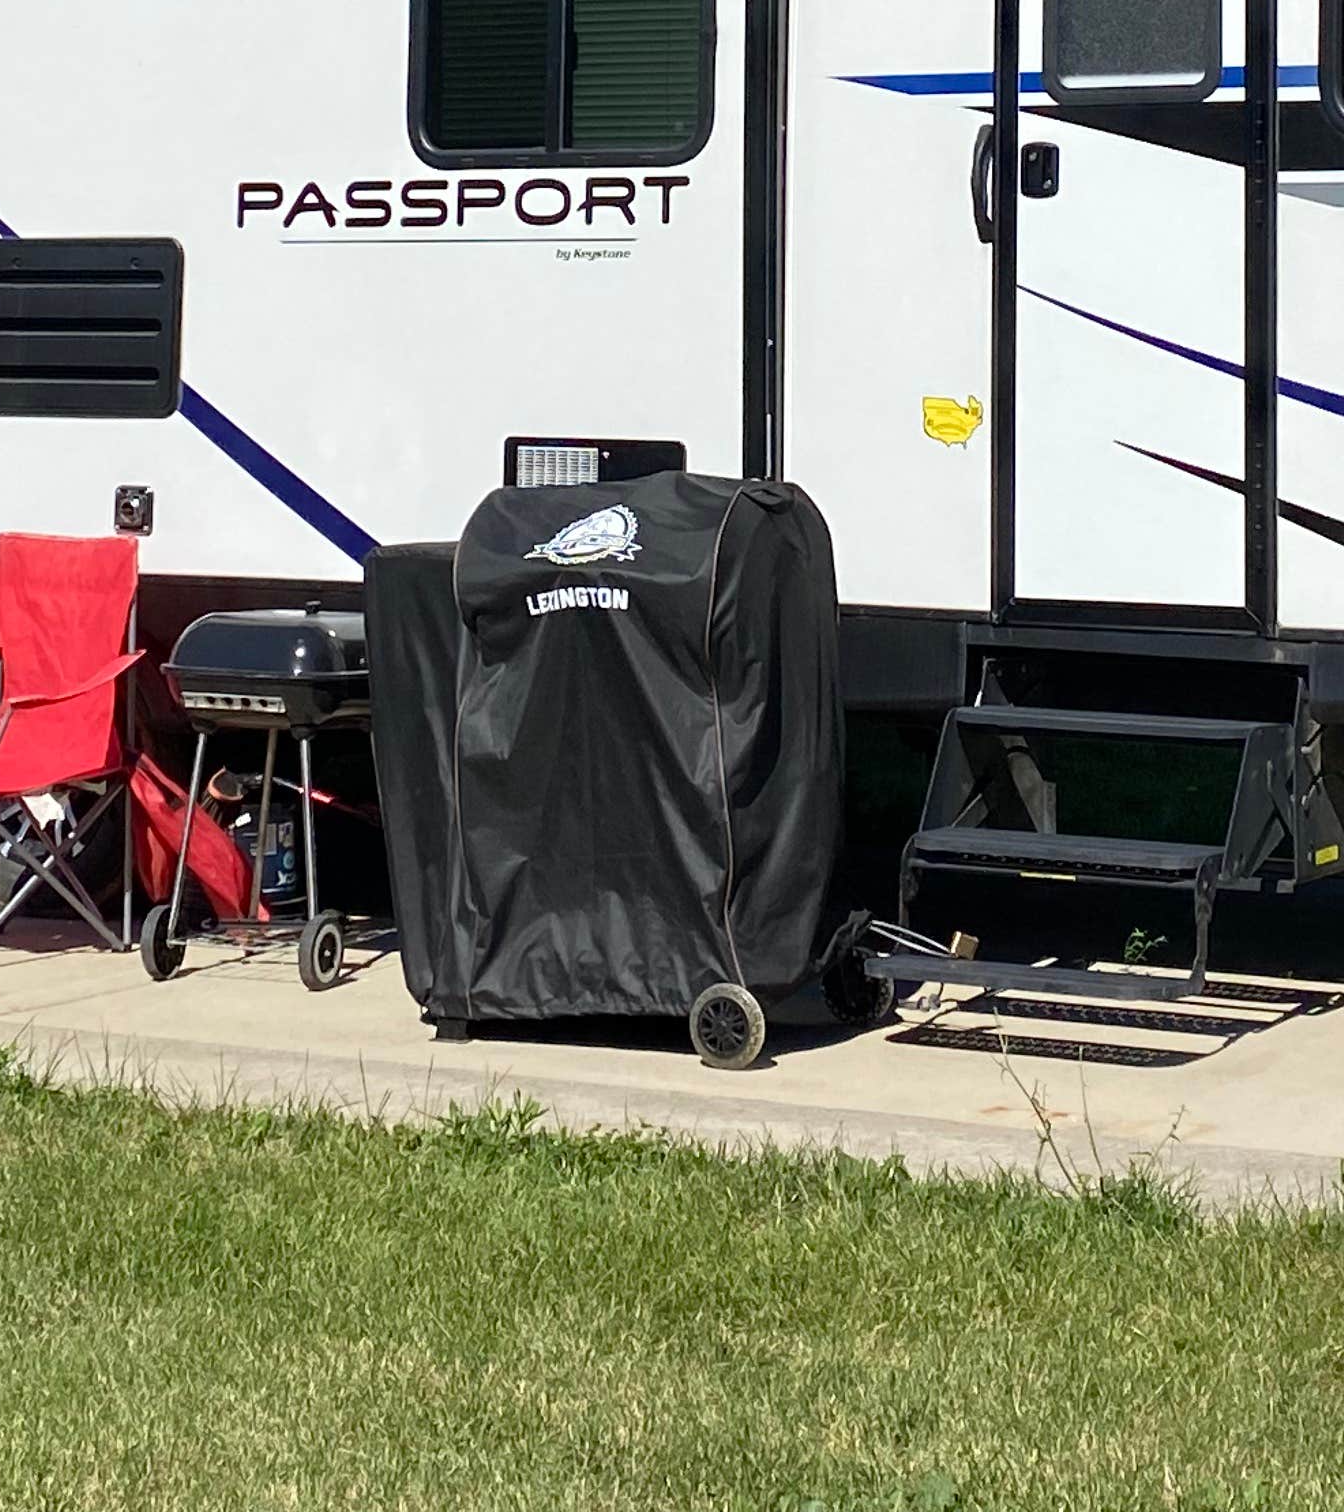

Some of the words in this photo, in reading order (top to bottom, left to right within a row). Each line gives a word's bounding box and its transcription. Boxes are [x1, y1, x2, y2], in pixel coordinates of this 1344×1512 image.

[236, 175, 691, 229] PASSPORT
[555, 248, 571, 261] by
[573, 248, 632, 261] Keystone
[526, 586, 630, 617] LEXINGTON
